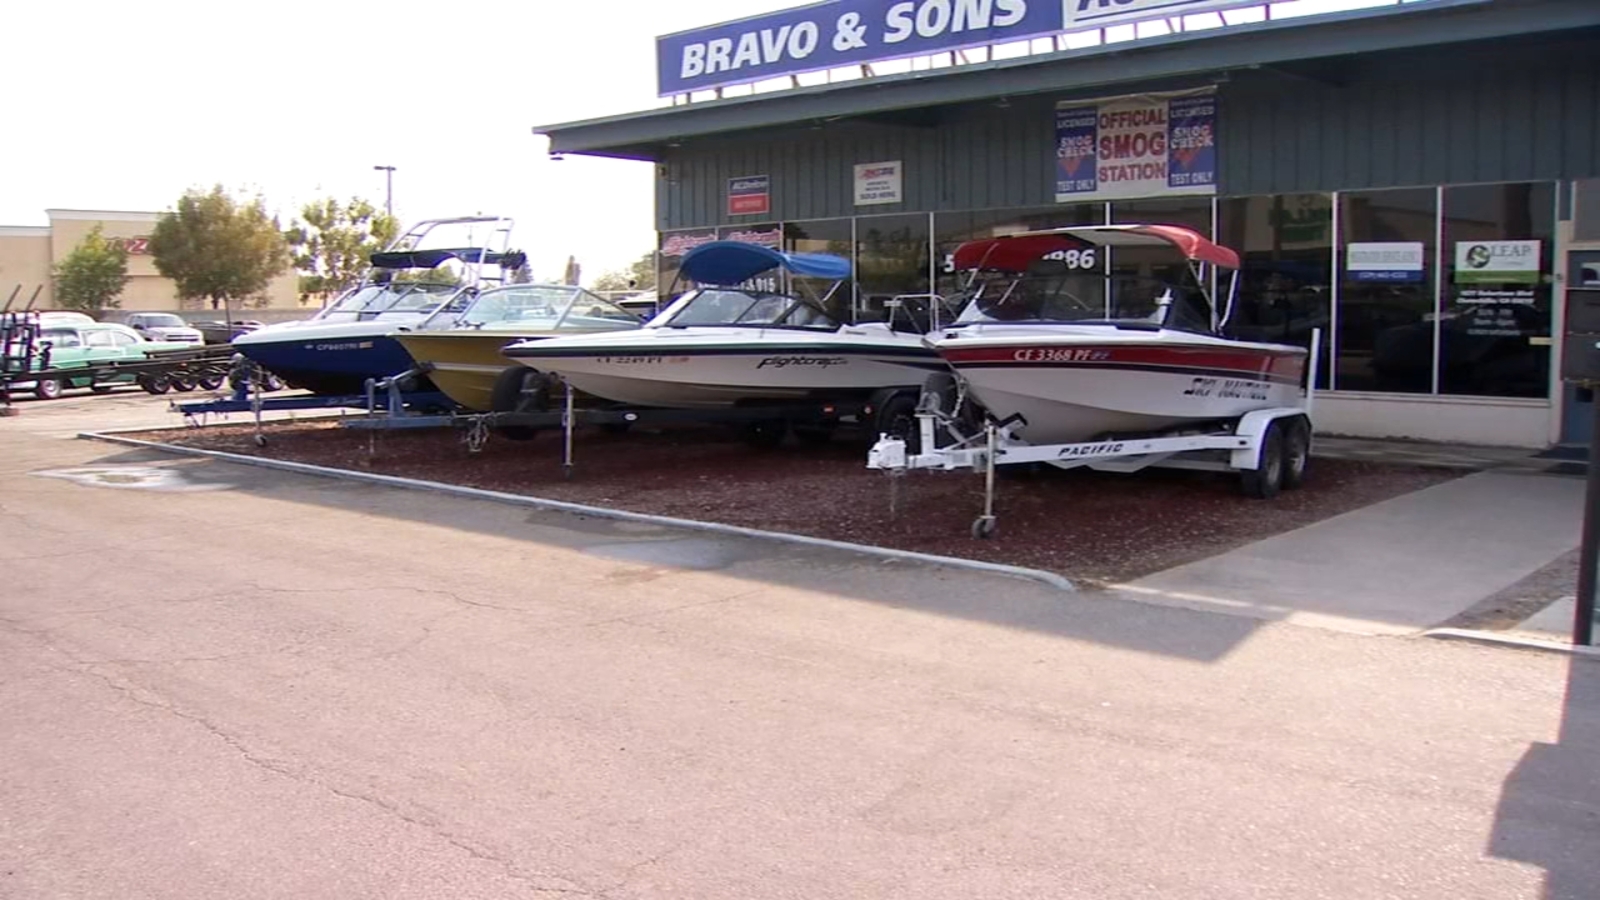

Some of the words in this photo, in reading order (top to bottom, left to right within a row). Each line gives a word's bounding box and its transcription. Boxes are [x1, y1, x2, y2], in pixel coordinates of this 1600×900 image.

[680, 20, 819, 79] BRAVO
[832, 11, 868, 51] &
[883, 0, 1028, 43] SONS
[1171, 106, 1214, 118] LICENSED
[1057, 117, 1096, 129] LICENSED
[1100, 108, 1166, 130] OFFICIAL
[1173, 125, 1211, 138] SMOG
[1060, 135, 1093, 148] SMOG
[1100, 131, 1165, 160] SMOG
[1170, 135, 1213, 149] CHECK
[1057, 145, 1094, 158] CHECK
[1099, 161, 1167, 183] STATION
[1171, 173, 1190, 186] TEST
[1192, 171, 1213, 184] ONLY
[1057, 180, 1075, 192] TEST
[1077, 179, 1095, 191] ONLY
[1491, 245, 1532, 257] LEAP
[1014, 349, 1033, 361] CF
[1035, 349, 1072, 361] 3368
[1058, 443, 1124, 457] PACIFIC
